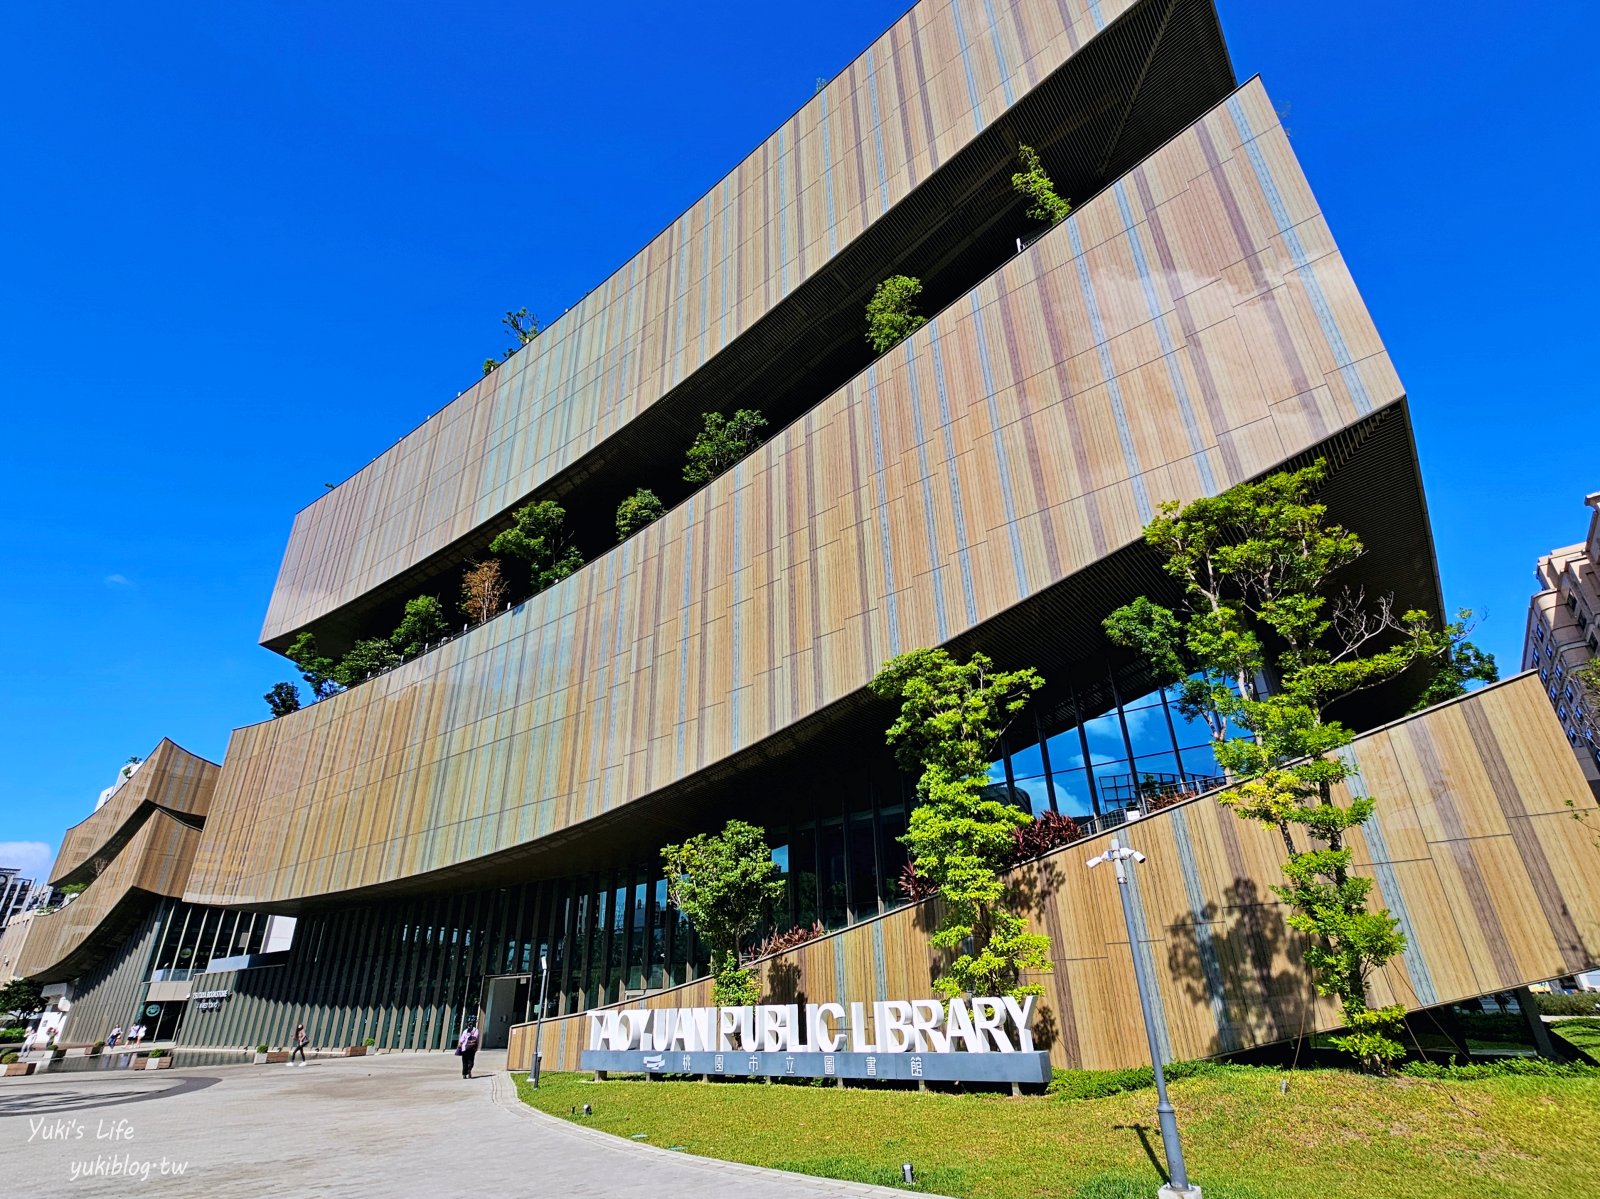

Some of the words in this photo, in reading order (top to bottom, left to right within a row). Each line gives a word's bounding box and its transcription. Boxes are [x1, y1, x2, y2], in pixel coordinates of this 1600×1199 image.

[586, 1008, 717, 1053] TAOYUAN
[718, 1002, 847, 1054] PUBLIC
[850, 994, 1040, 1055] LIBRARY
[682, 1053, 923, 1077] 桃園市立圖書館
